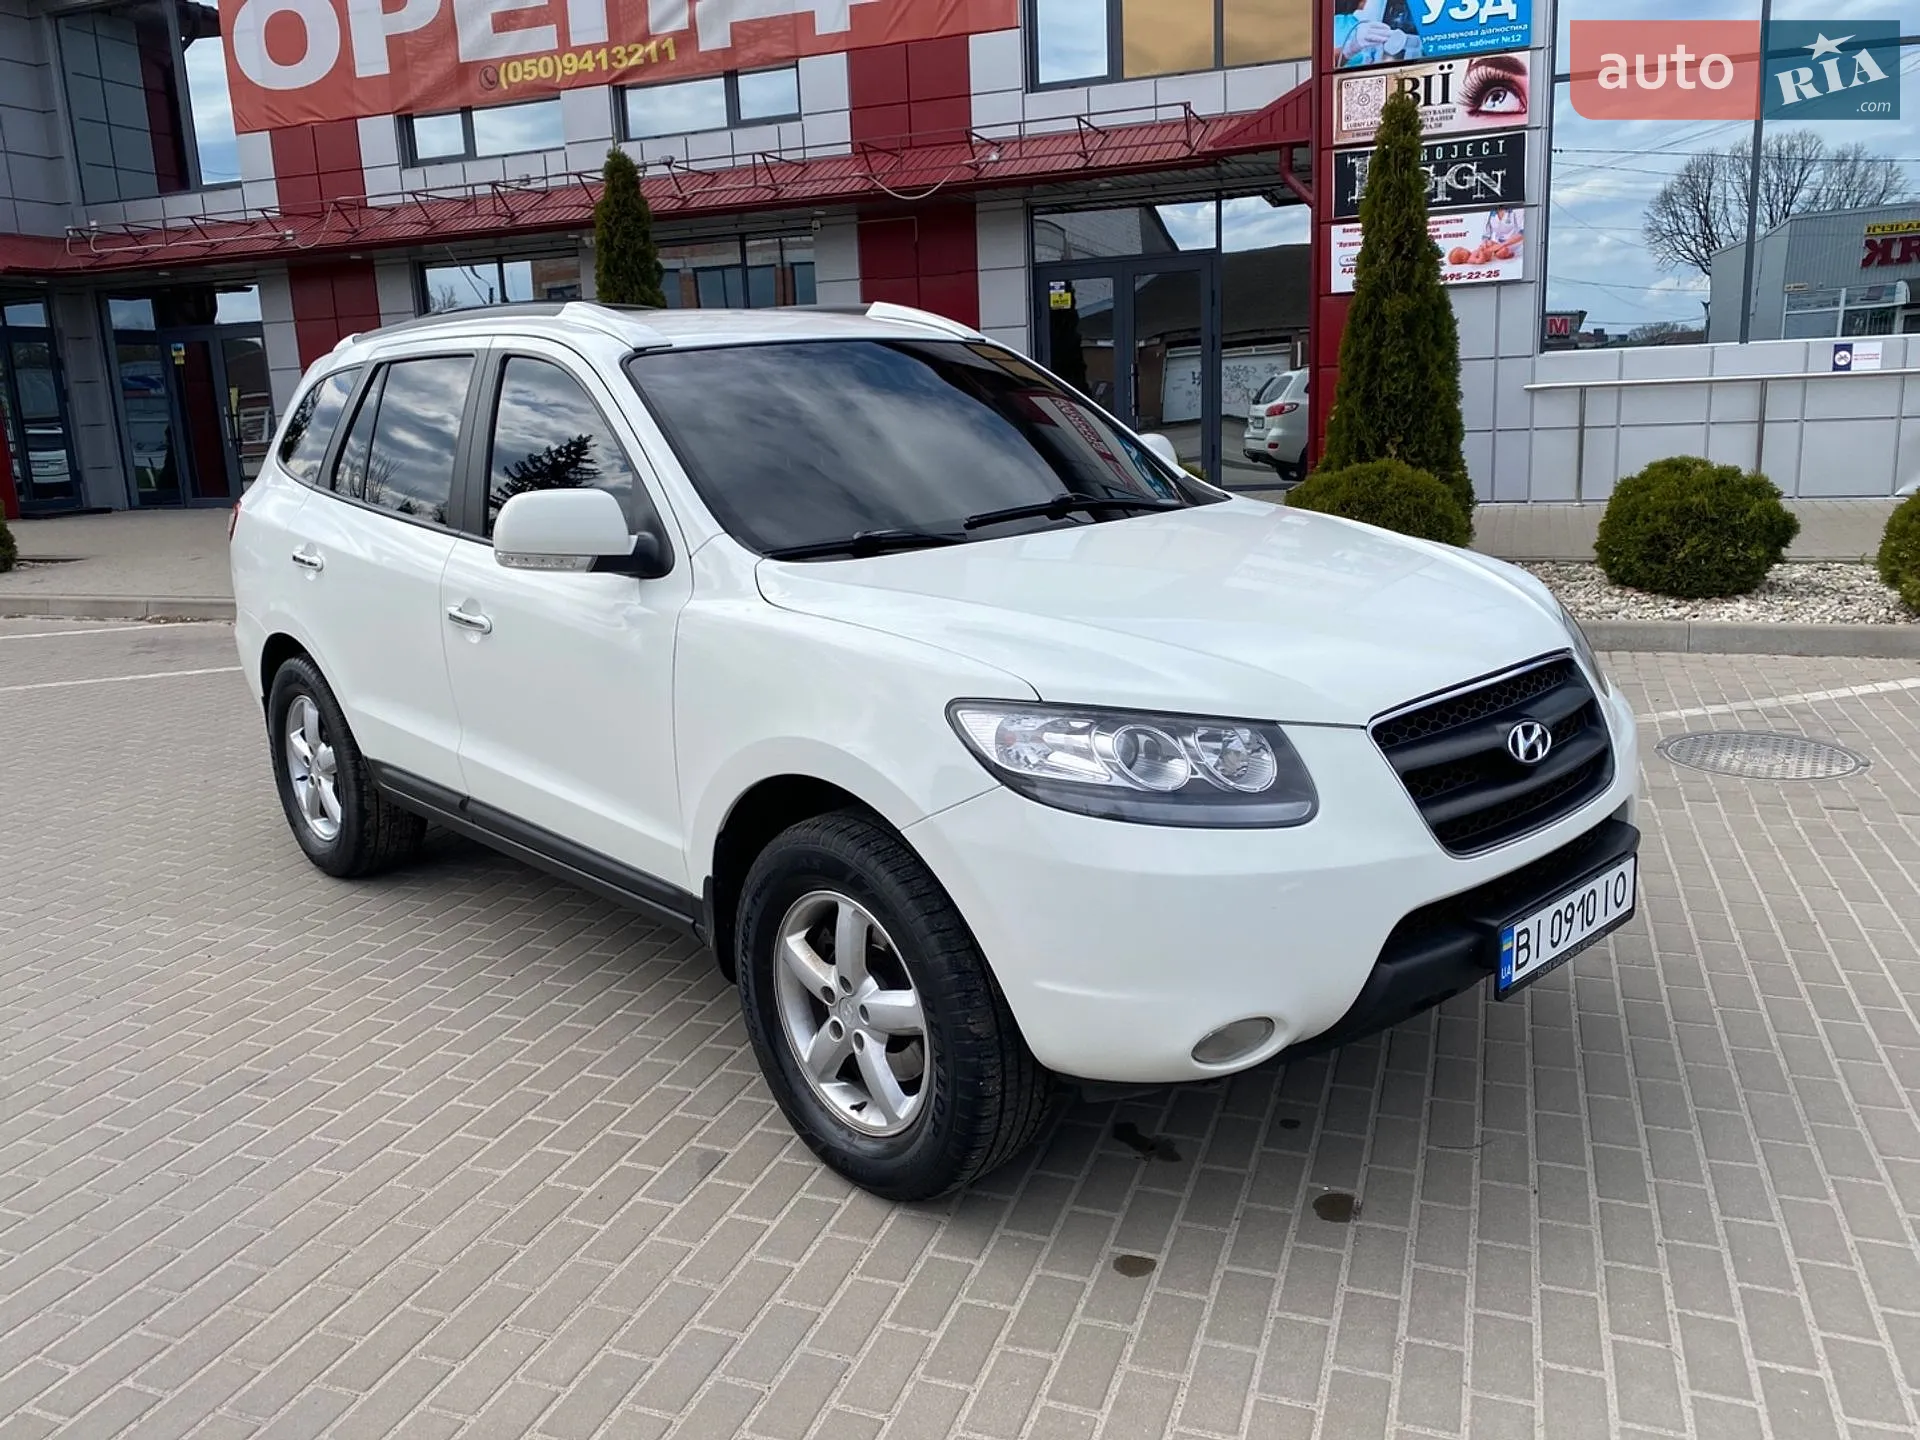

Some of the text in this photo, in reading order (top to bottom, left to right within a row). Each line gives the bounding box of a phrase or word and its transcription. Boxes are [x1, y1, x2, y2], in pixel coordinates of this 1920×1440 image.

[1421, 0, 1517, 24] УЗД
[234, 0, 880, 90] ОРЕ
[499, 38, 677, 89] (050)9413211
[1421, 140, 1505, 161] ROJECT
[1514, 918, 1542, 973] BI
[1550, 888, 1598, 948] 0910
[1604, 871, 1627, 918] IO
[1501, 965, 1512, 979] UA
